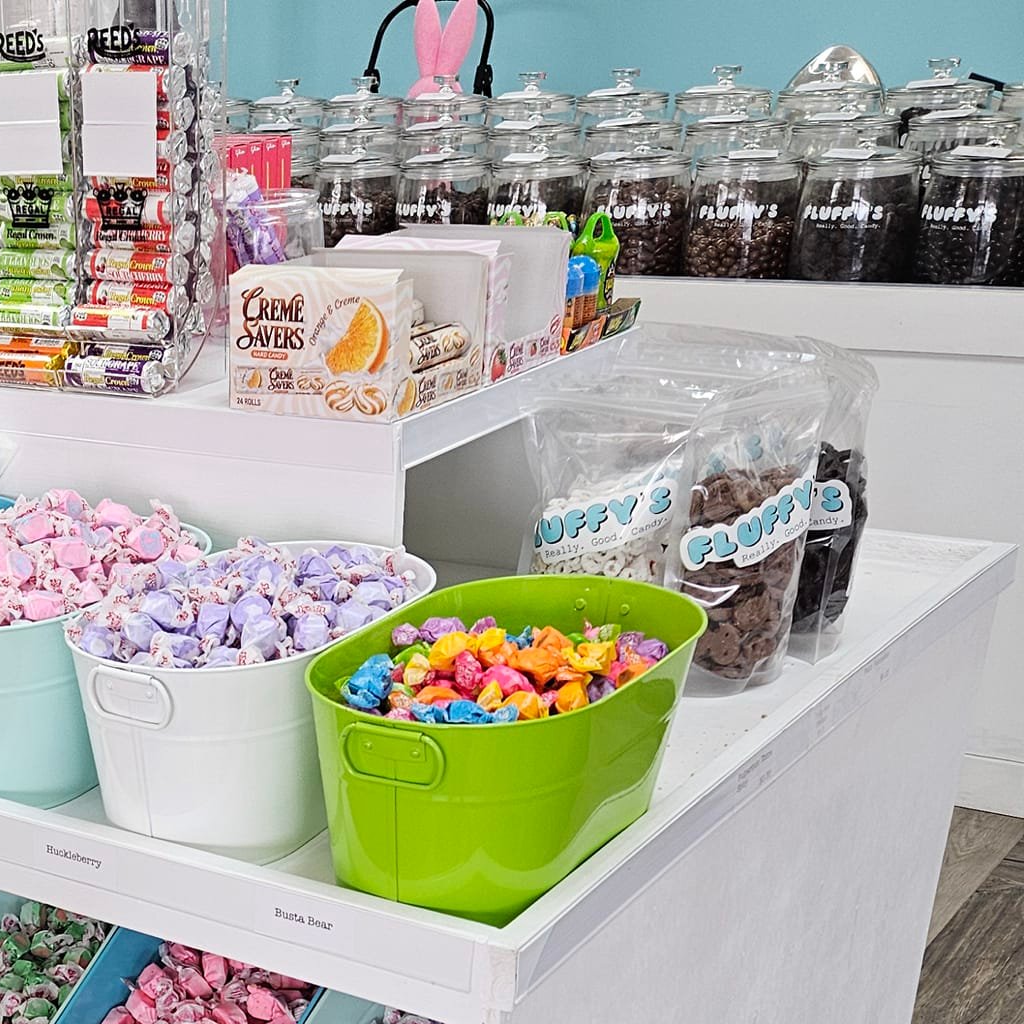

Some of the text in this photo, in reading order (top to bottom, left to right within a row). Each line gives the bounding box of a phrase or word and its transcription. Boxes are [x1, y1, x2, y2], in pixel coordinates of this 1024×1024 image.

[87, 23, 141, 54] REED'S
[16, 205, 45, 214] REGAL
[106, 206, 138, 216] REGAL
[804, 203, 884, 221] FLUFFY'S
[921, 204, 998, 223] FLUFFY'S
[131, 261, 154, 270] Crown
[131, 293, 155, 304] Crown
[240, 286, 305, 324] CREME
[308, 295, 361, 347] Orange & Creme
[236, 318, 305, 350] SAVERS
[127, 352, 150, 361] Crown
[252, 352, 287, 360] HARD CANDY
[268, 367, 293, 381] CREME
[267, 379, 294, 390] SAVERS
[237, 397, 261, 406] 24 ROLLS
[544, 517, 668, 559] Really. Good. Candy.
[742, 517, 809, 562] Really. Good.
[46, 844, 102, 870] Huckleberry
[275, 907, 334, 931] Busta Bear
